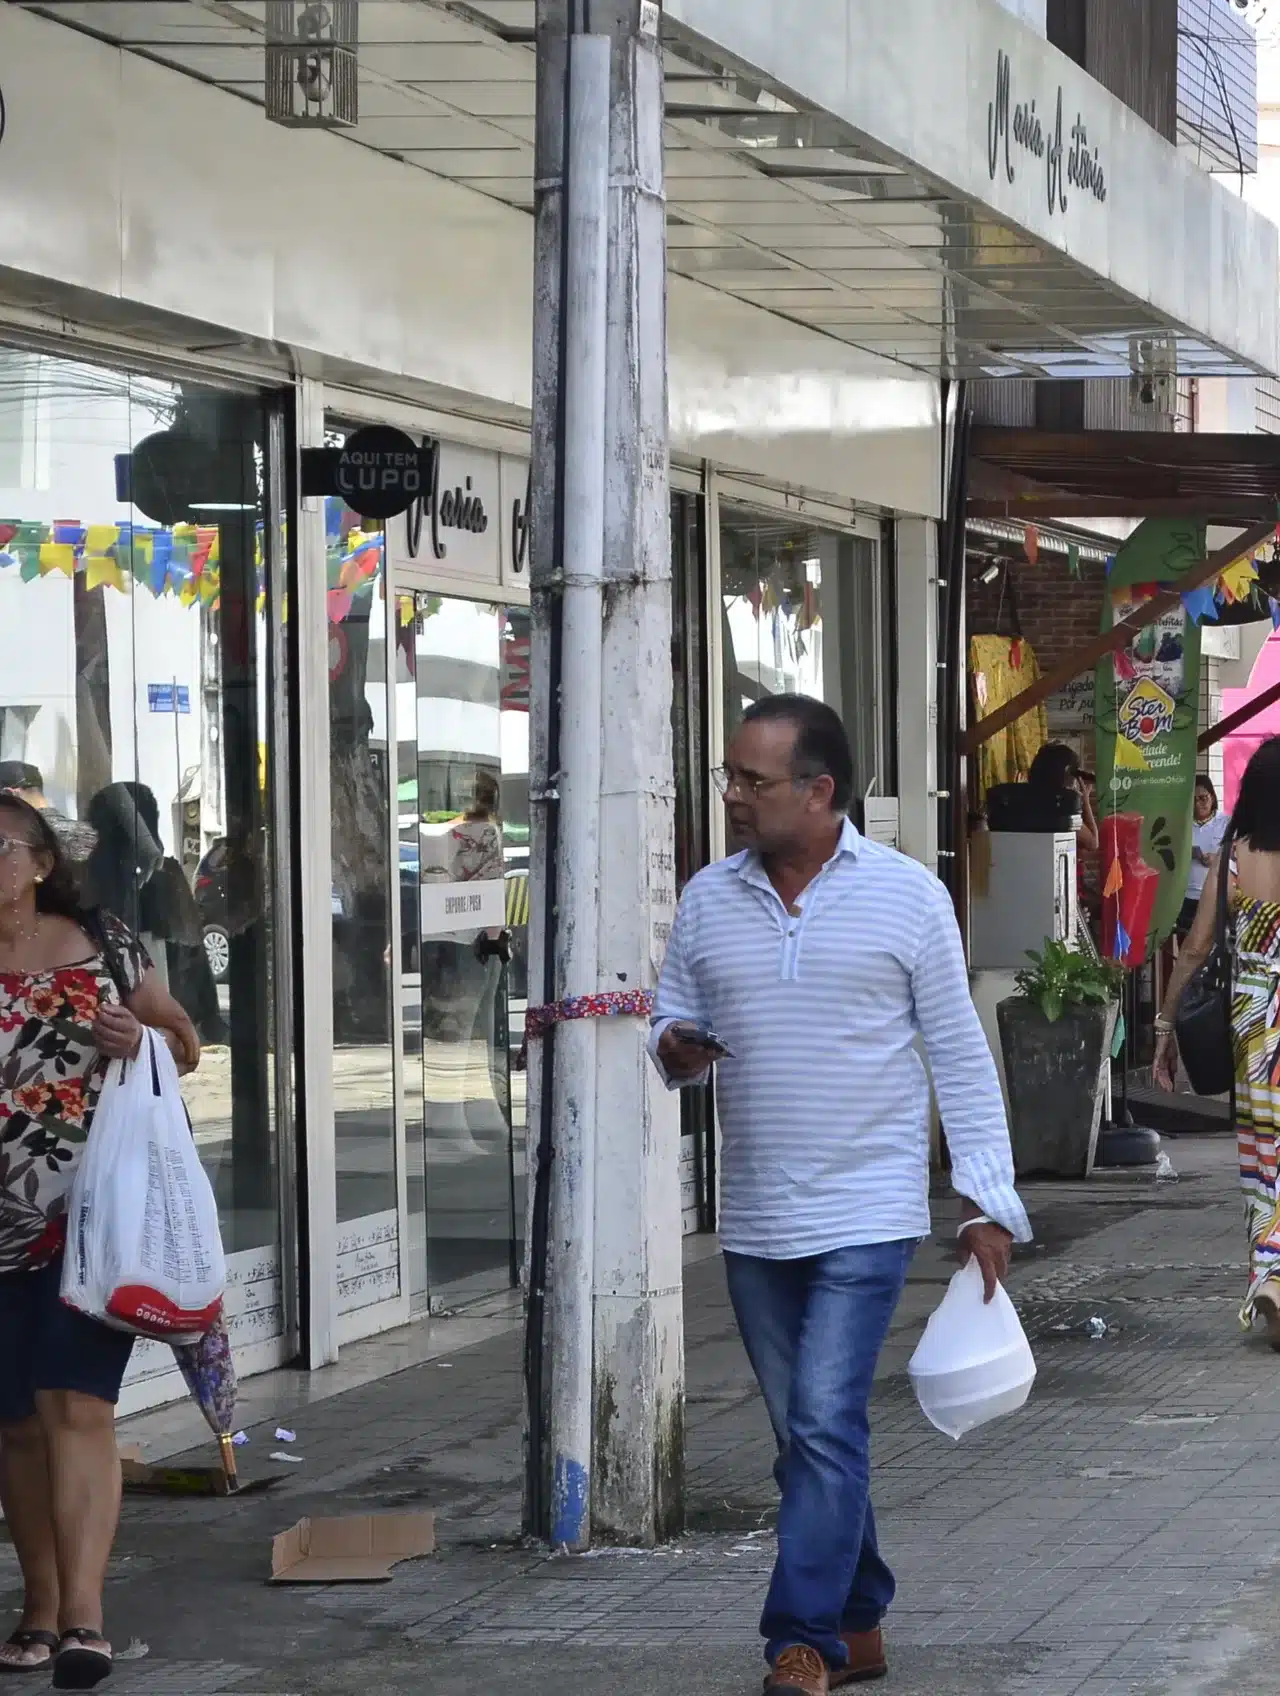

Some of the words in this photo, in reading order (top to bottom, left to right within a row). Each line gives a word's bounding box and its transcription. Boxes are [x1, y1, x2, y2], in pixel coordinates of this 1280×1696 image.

[987, 48, 1044, 185] Maria
[339, 452, 380, 465] AQUI
[385, 452, 418, 466] TEM
[336, 467, 420, 493] LUPO
[1126, 695, 1167, 718] Ster
